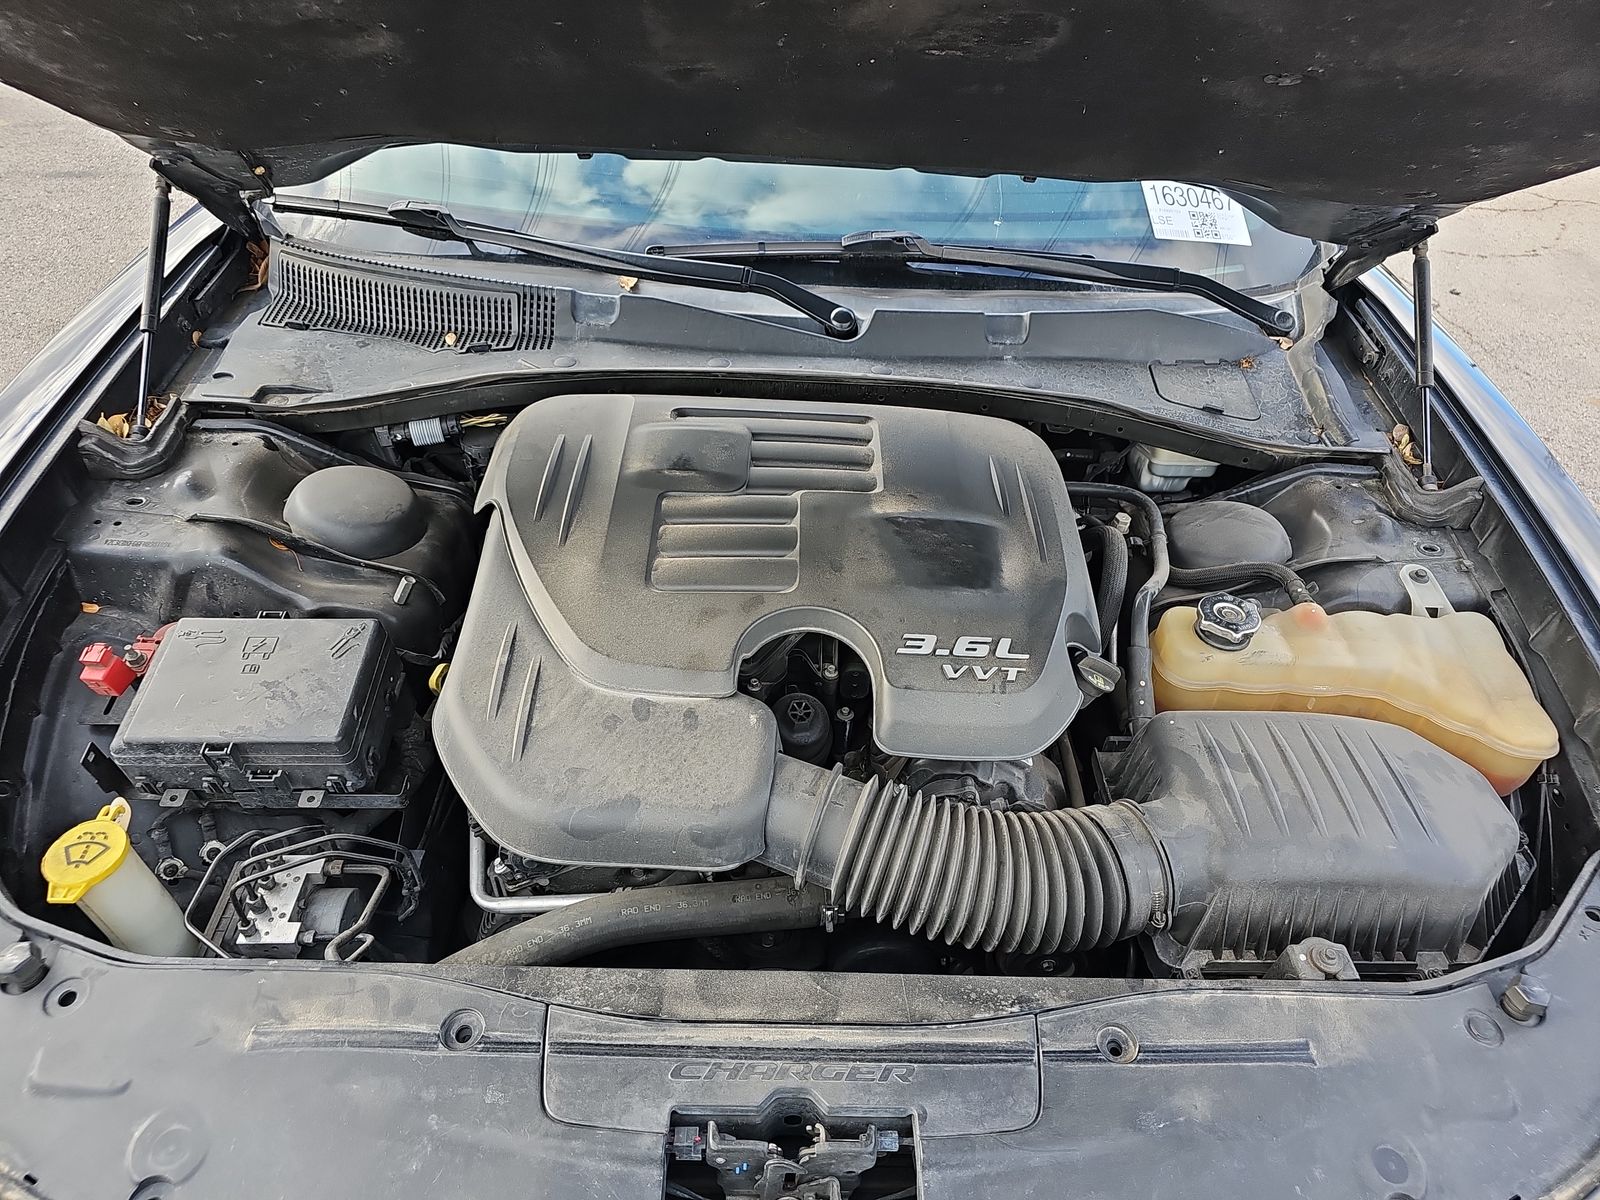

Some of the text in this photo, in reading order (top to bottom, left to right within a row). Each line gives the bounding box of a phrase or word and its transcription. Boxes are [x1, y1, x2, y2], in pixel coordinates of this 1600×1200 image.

[895, 633, 1030, 660] 3.6L
[941, 664, 1027, 683] VVT
[755, 891, 773, 901] END
[620, 906, 639, 917] RAD
[643, 903, 661, 913] END
[505, 944, 523, 958] RAD
[526, 935, 544, 948] END
[556, 916, 593, 935] 36.3MM
[669, 1061, 917, 1085] CHARGER
